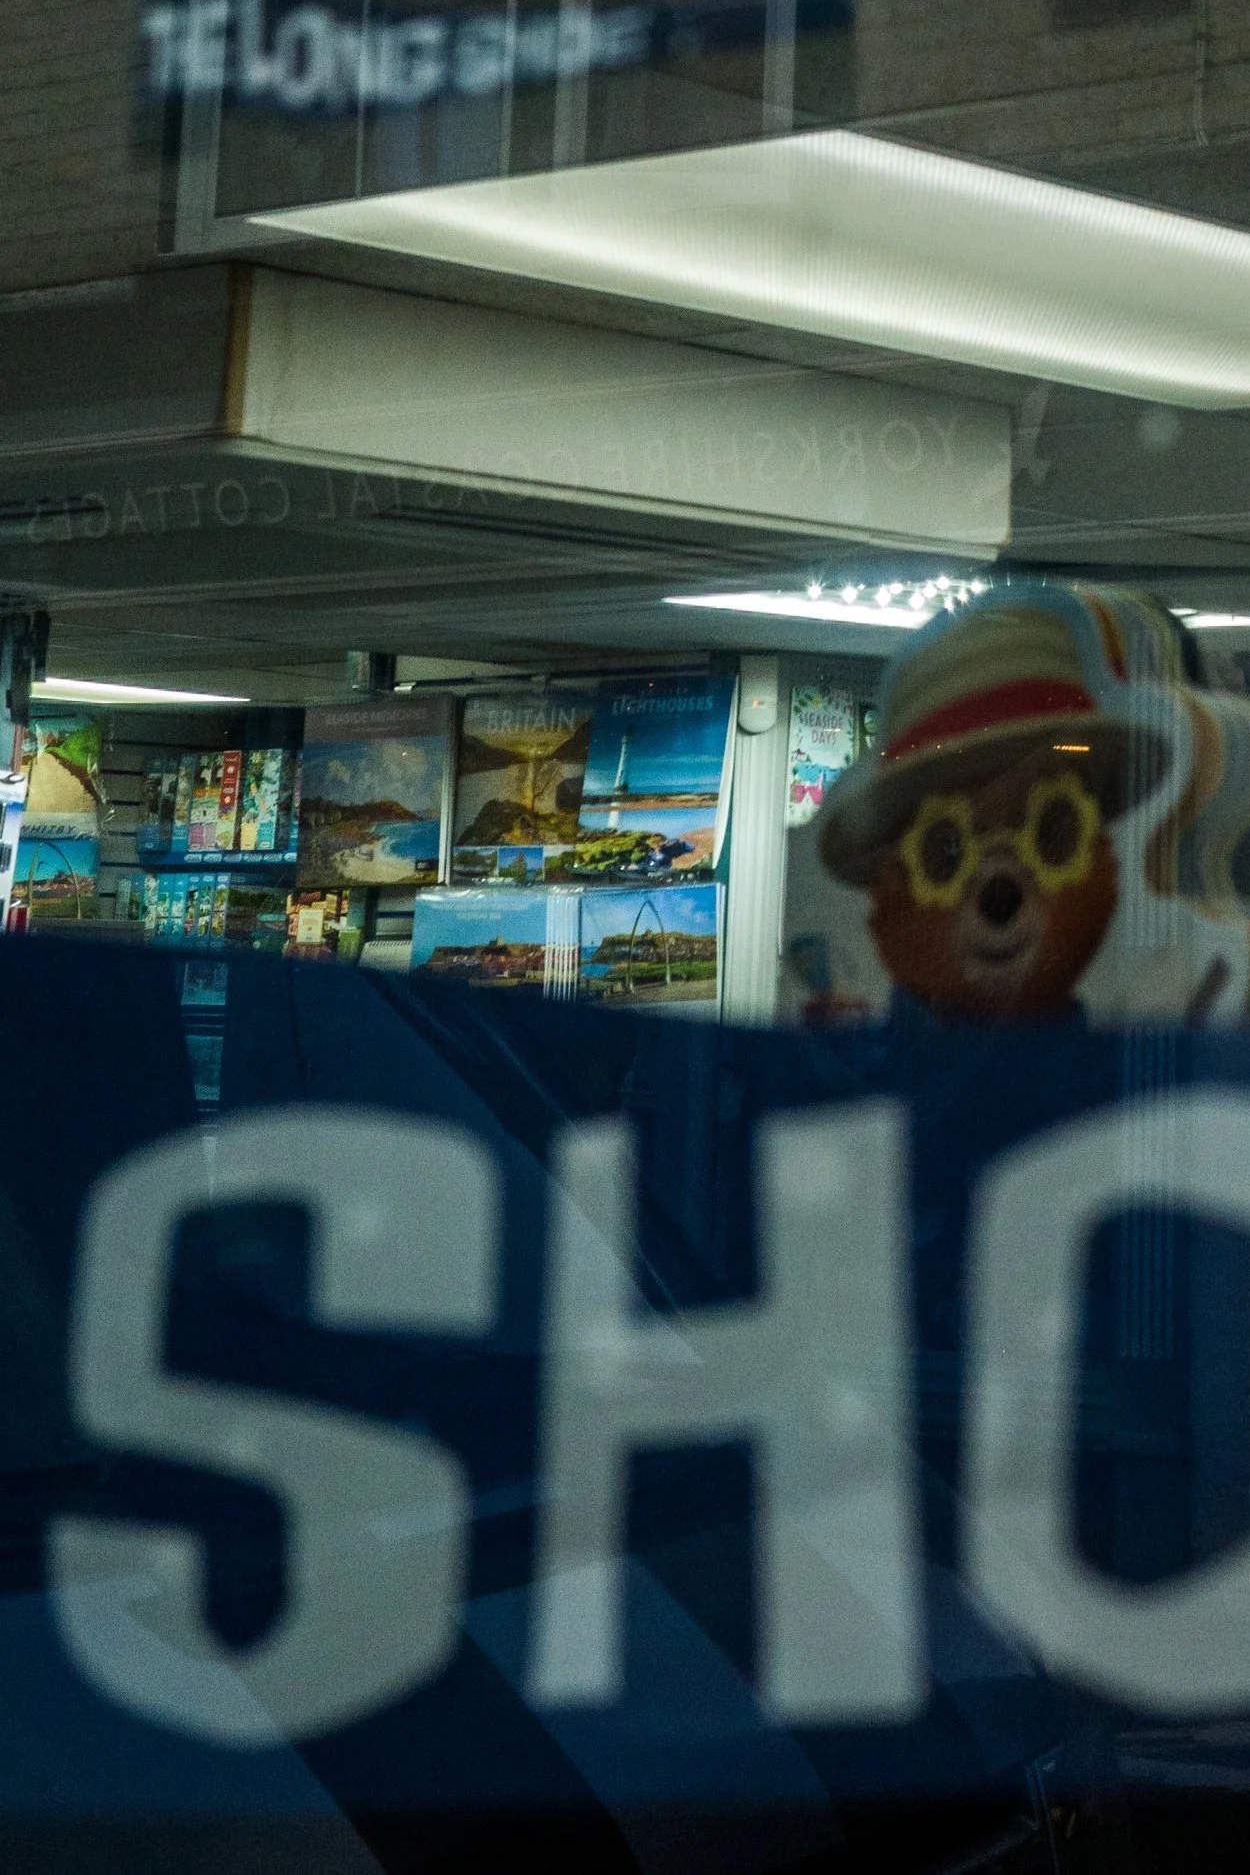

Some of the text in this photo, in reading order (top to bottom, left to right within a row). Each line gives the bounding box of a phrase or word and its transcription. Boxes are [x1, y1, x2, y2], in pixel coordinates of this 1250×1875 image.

[611, 695, 714, 716] LIGHTHOUSES
[487, 706, 576, 735] BRITAIN
[803, 713, 844, 729] SEASIDE
[811, 729, 837, 745] DAYS
